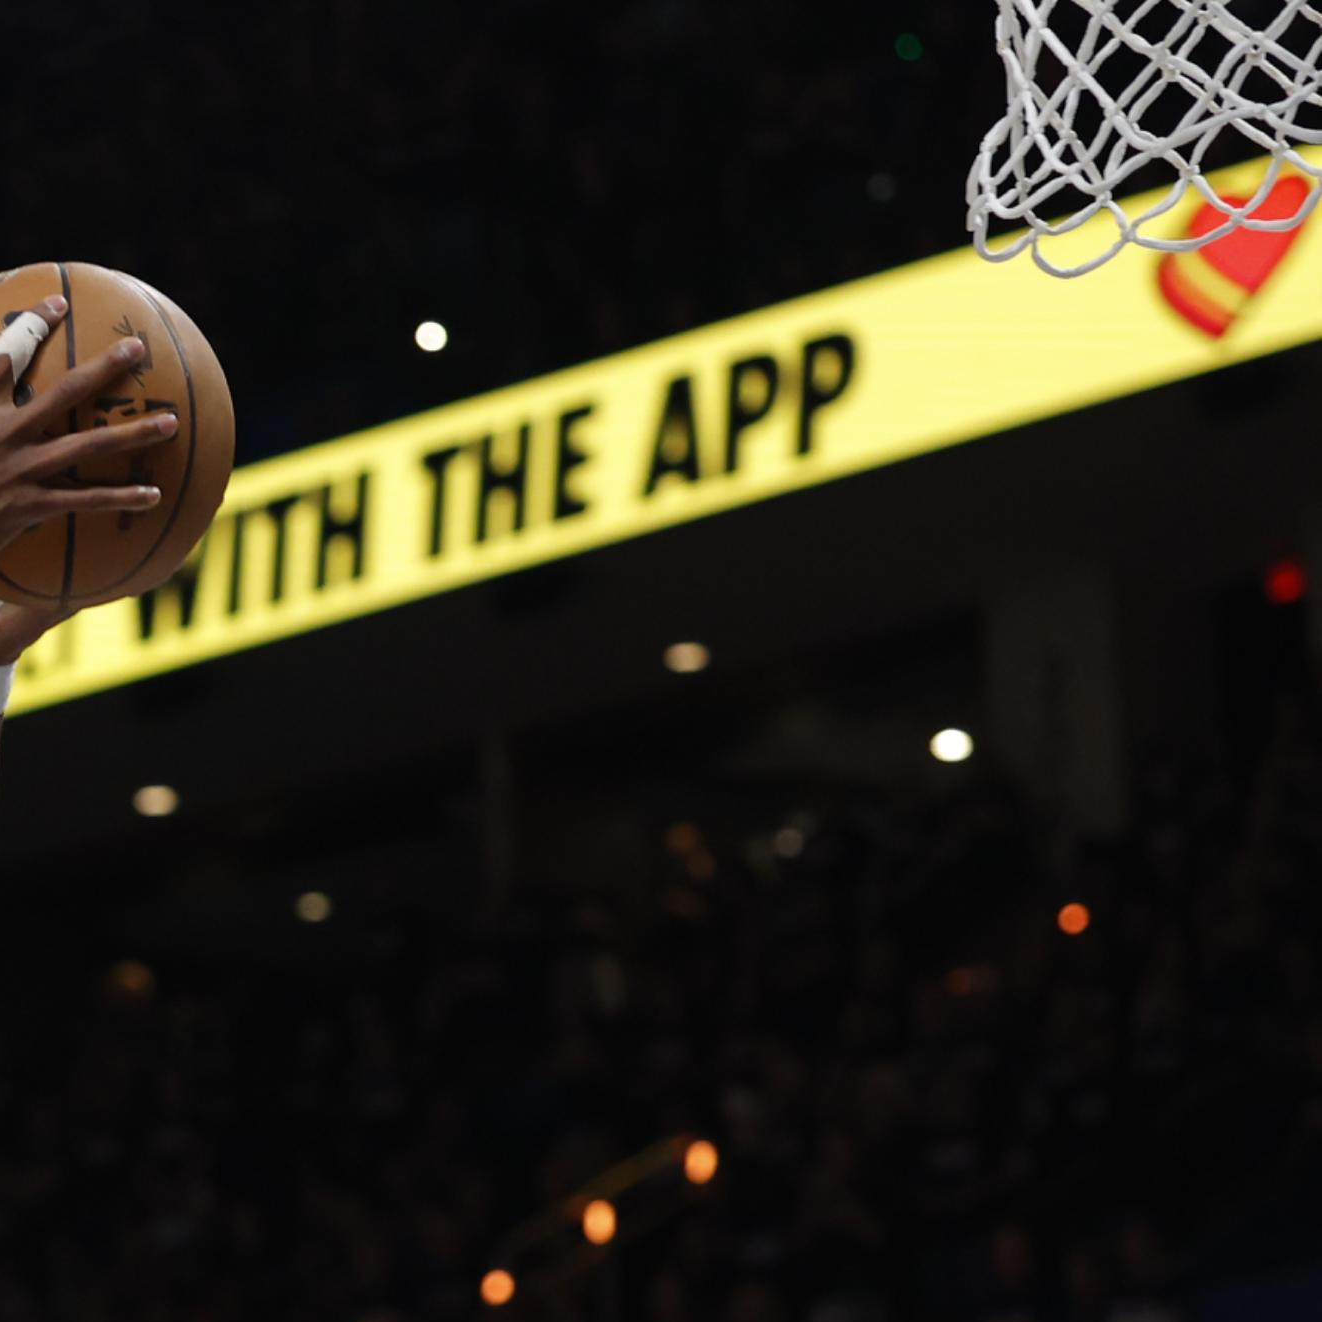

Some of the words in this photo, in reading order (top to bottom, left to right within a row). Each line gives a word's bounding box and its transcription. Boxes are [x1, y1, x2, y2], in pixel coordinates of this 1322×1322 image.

[137, 470, 371, 642] WITH
[422, 404, 595, 560] THE
[643, 334, 855, 498] APP
